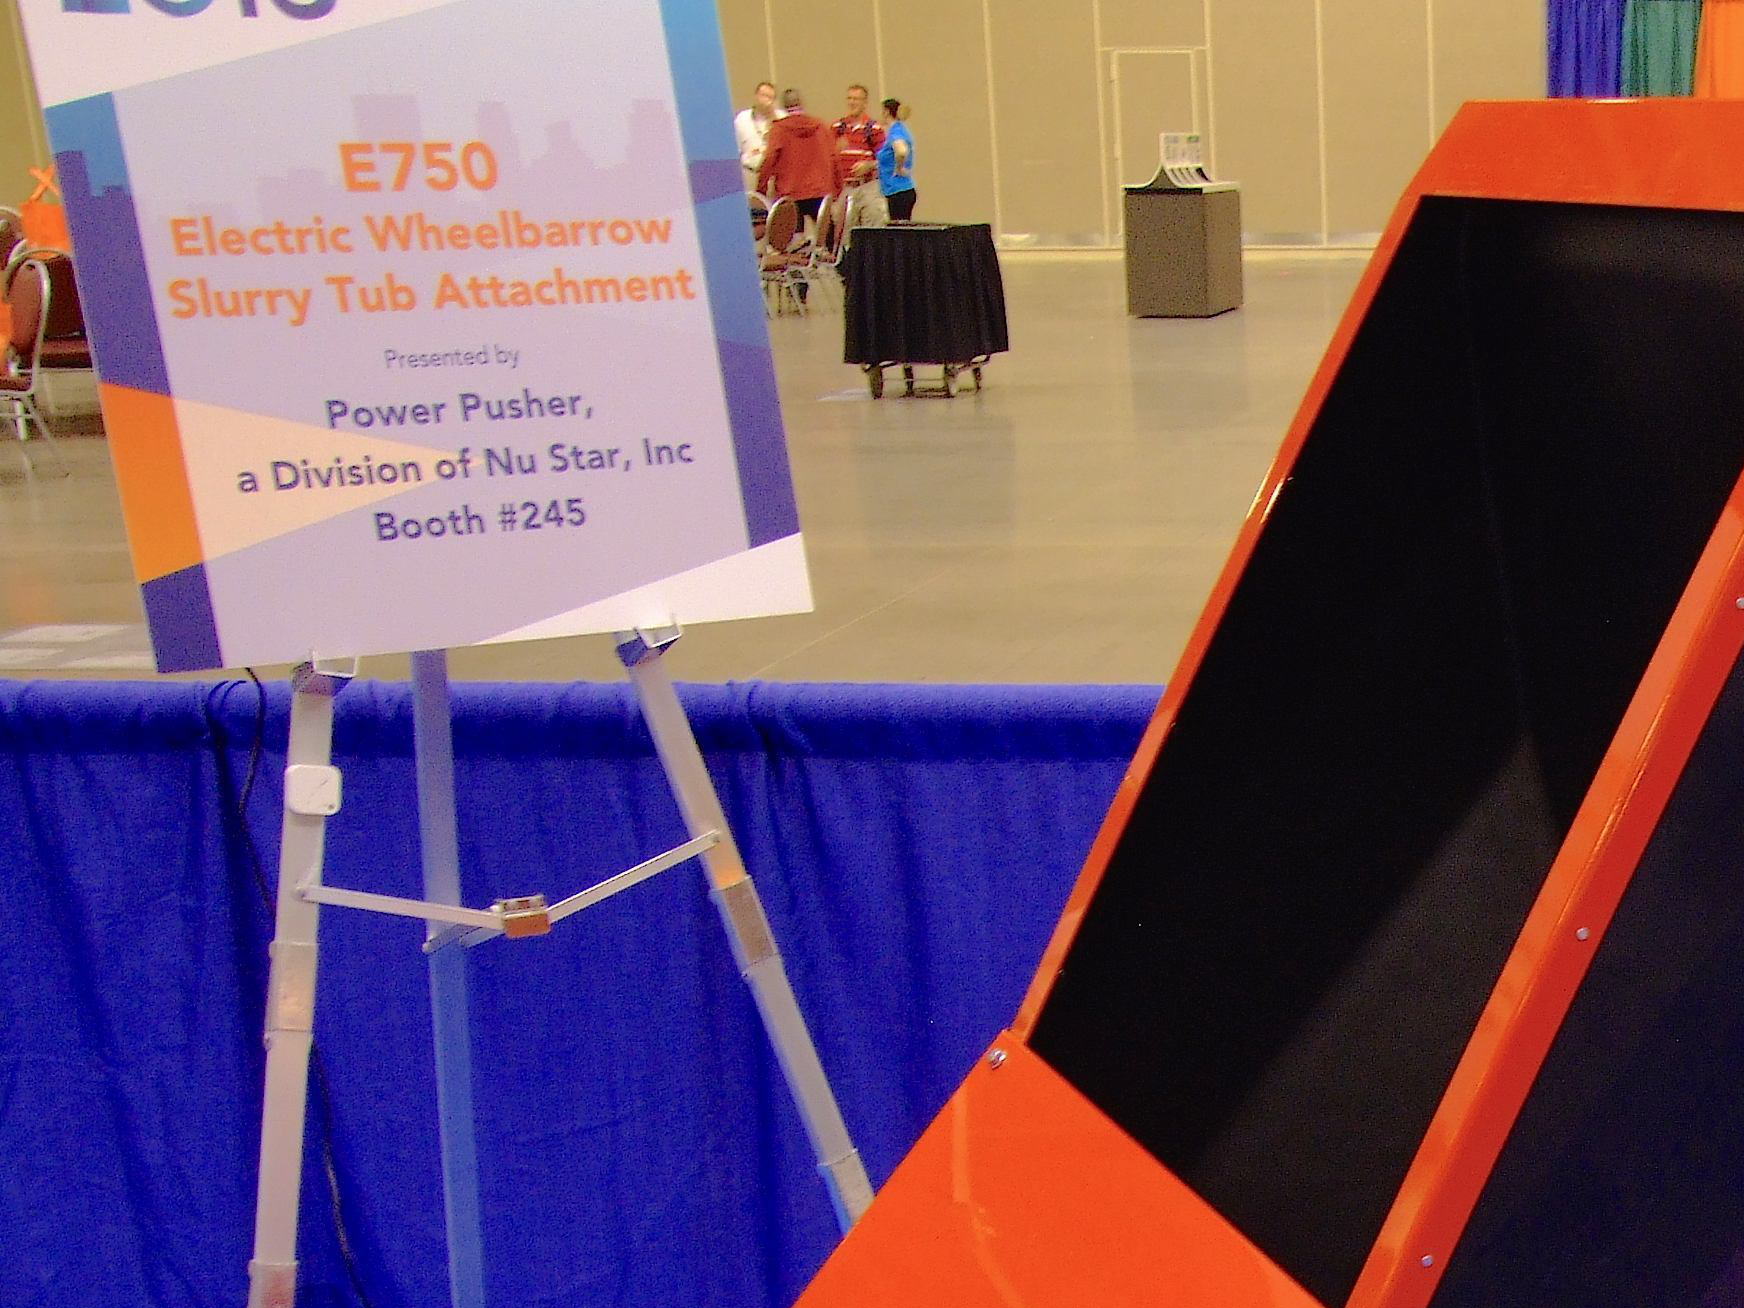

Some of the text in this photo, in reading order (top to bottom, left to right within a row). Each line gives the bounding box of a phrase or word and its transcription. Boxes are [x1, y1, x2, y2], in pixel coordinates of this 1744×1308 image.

[339, 141, 497, 192] E750
[168, 209, 672, 257] Electric Wheelbarrow
[167, 267, 696, 327] Slurry Tub Attachment
[384, 343, 520, 370] Presented by
[326, 387, 593, 429] Power Pusher,
[237, 437, 695, 493] a Division of Nu Star, Inc
[374, 497, 587, 541] Booth #245
